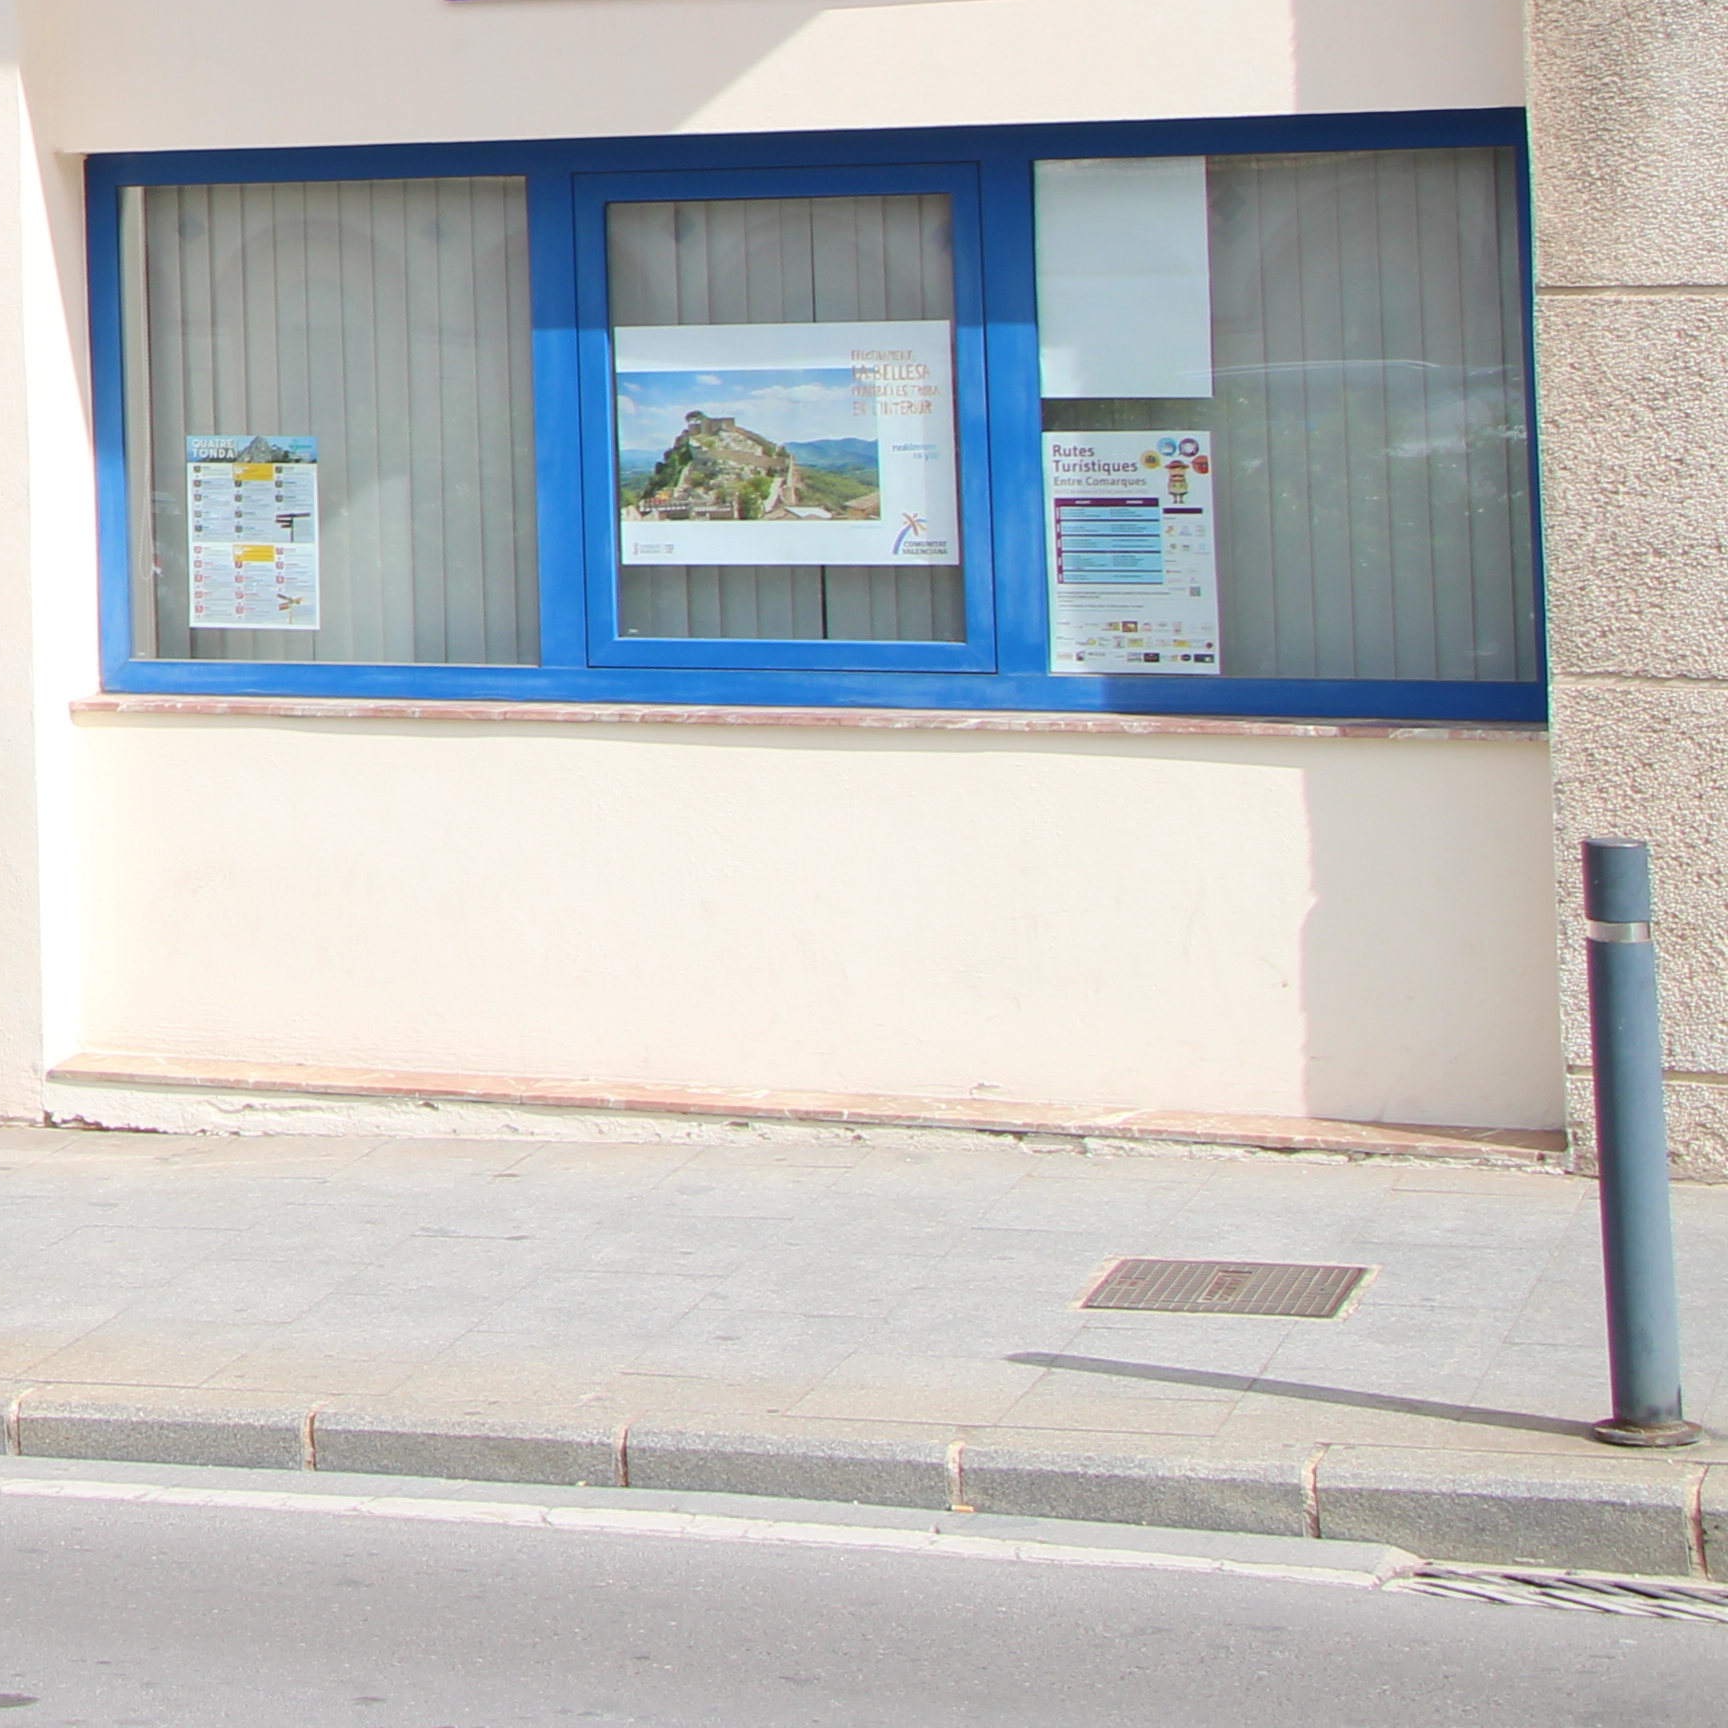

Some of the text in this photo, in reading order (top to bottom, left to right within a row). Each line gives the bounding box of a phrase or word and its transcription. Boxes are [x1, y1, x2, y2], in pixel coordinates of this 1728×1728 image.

[852, 363, 931, 381] LA BELLESA
[192, 439, 234, 448] QUATRE
[192, 449, 237, 459] TONDA
[1052, 444, 1095, 457] Rutes
[1052, 459, 1138, 476] Turístiques
[1053, 476, 1147, 488] Entre Comarques
